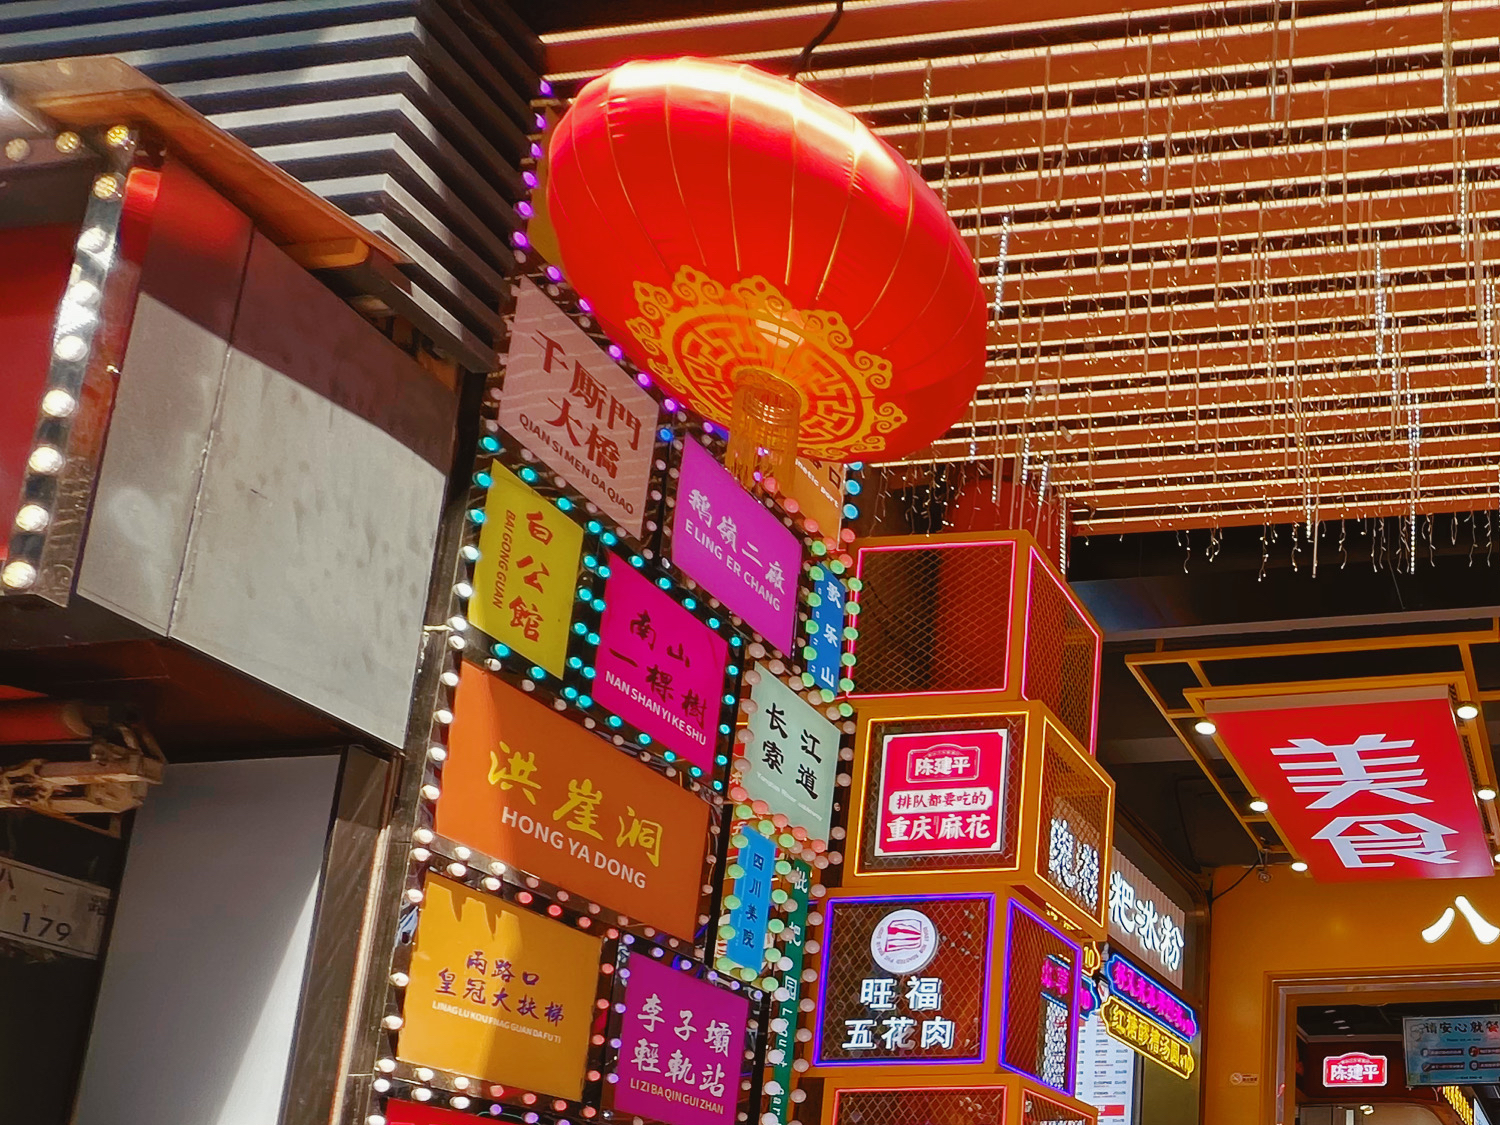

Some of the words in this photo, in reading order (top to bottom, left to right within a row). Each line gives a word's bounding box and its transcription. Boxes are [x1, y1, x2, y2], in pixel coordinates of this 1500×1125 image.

[519, 413, 551, 445] QIAN
[552, 440, 563, 456] SI
[563, 450, 590, 479] MEN
[591, 473, 606, 493] DA
[607, 488, 634, 515] QIAO
[505, 509, 516, 533] BAI
[498, 532, 513, 571] GONG
[685, 519, 694, 535] E
[694, 527, 723, 560] LING
[726, 555, 742, 577] ER
[743, 571, 780, 611] CHANG
[492, 571, 507, 609] GUAN
[605, 670, 630, 695] NAN
[630, 688, 661, 715] SHAN
[661, 707, 671, 722] YI
[671, 715, 685, 732] KE
[685, 724, 707, 745] SHU
[914, 755, 971, 777] 陈建平
[488, 741, 663, 867] 洪崖洞
[896, 791, 987, 810] 排队都要吃的
[1270, 734, 1460, 868] 美食
[501, 806, 564, 850] HONG
[568, 837, 591, 863] YA
[593, 851, 647, 888] DONG
[886, 813, 992, 843] 重庆麻花
[22, 912, 72, 941] 179
[435, 967, 565, 1027] 皇冠大扶梯
[858, 976, 944, 1011] 旺福
[842, 1017, 955, 1051] 五花肉
[1330, 1063, 1380, 1081] 陈建平
